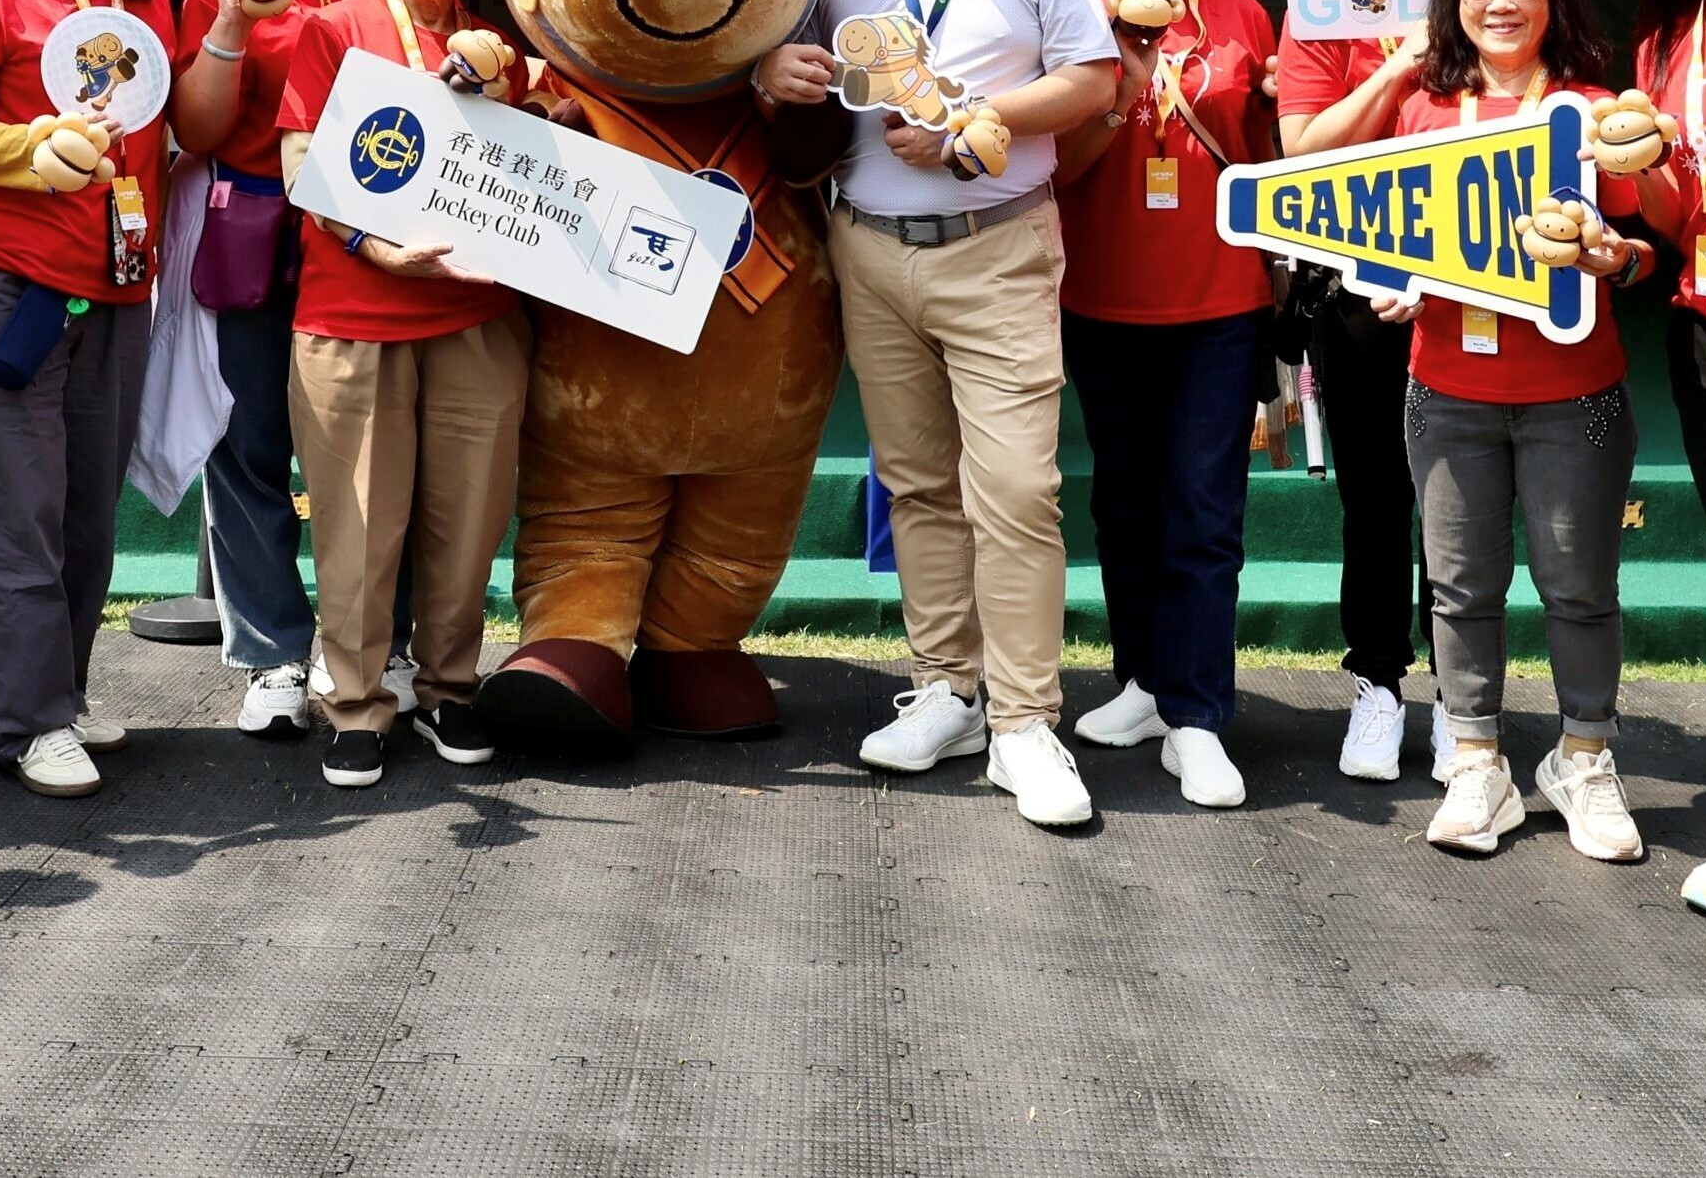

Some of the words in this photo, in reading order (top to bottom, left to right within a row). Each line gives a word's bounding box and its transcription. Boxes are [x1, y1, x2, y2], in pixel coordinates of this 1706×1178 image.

[438, 156, 472, 189] The
[477, 172, 530, 214] Hong
[532, 195, 583, 235] Kong
[447, 130, 599, 203] 香港賽馬會
[422, 187, 493, 234] Jockey
[495, 214, 541, 247] Club
[1272, 164, 1434, 262] GAME
[1457, 144, 1535, 282] ON
